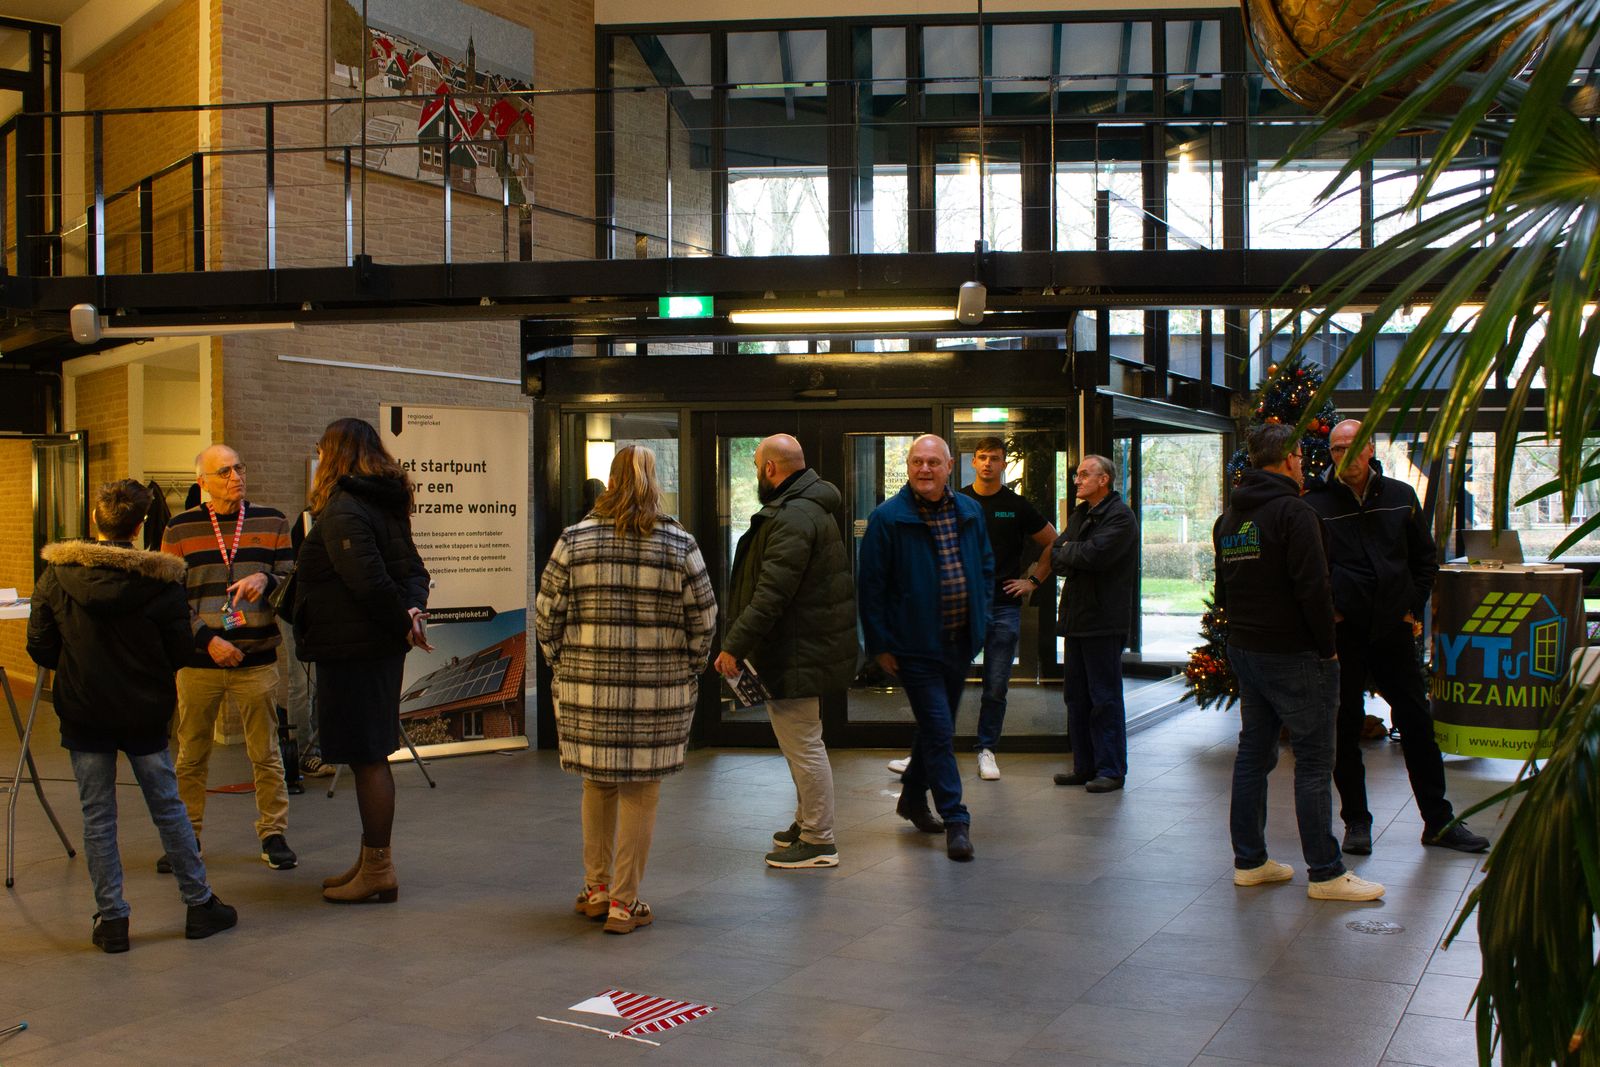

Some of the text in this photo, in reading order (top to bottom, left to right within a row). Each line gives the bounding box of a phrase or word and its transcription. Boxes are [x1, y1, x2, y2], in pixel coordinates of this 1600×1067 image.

[421, 459, 487, 475] startpunt
[411, 482, 454, 493] or een
[411, 501, 517, 517] urzame woning
